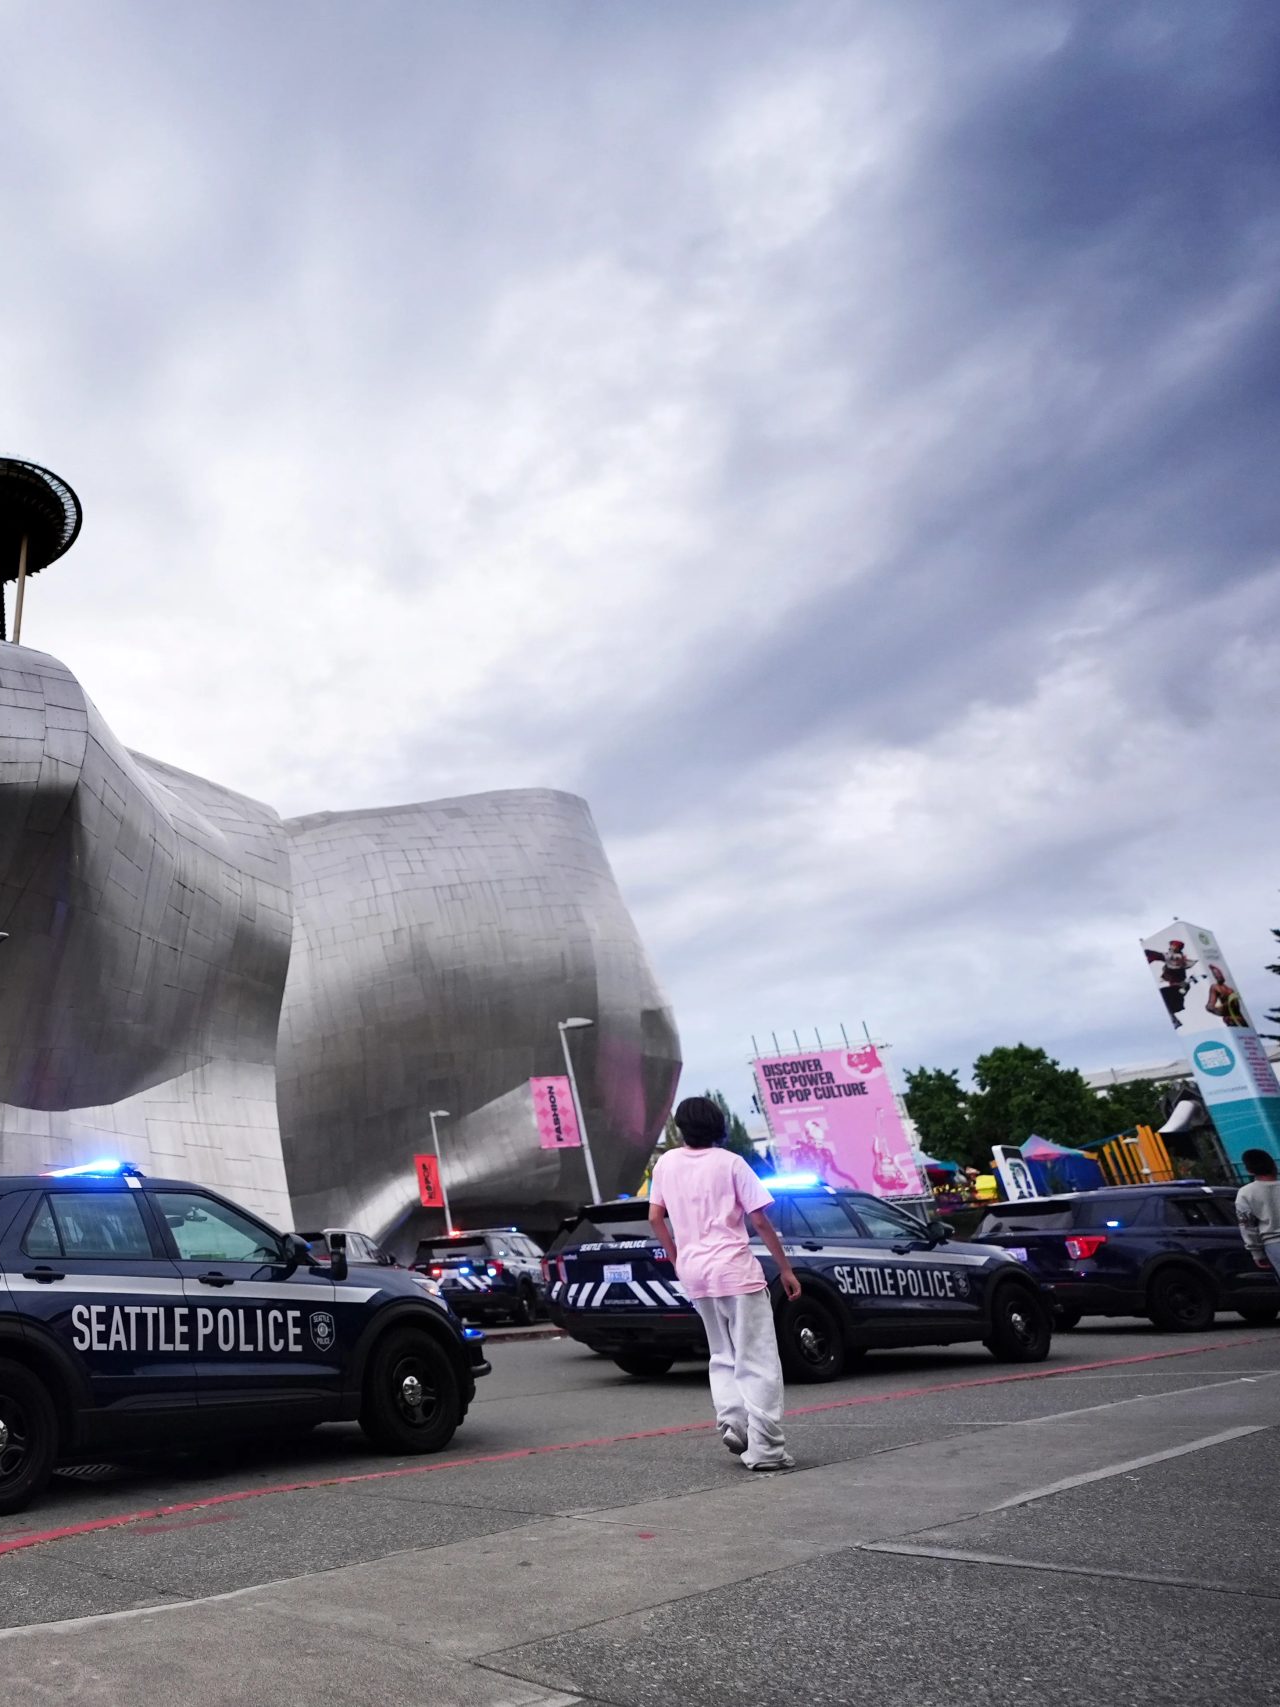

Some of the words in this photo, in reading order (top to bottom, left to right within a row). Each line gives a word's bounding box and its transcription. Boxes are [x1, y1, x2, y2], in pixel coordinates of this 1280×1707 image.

[762, 1059, 822, 1077] DISCOVER
[766, 1076, 789, 1091] THE
[790, 1071, 835, 1088] POWER
[770, 1091, 785, 1105] OF
[787, 1088, 812, 1103] POP
[814, 1082, 868, 1100] CULTURE
[547, 1086, 564, 1142] FASHION
[580, 1243, 603, 1252] SEATTLE
[620, 1240, 647, 1249] POLICE
[834, 1265, 896, 1296] SEATTLE
[896, 1269, 956, 1298] POLICE
[71, 1305, 189, 1351] SEATTLE
[197, 1307, 303, 1352] POLICE
